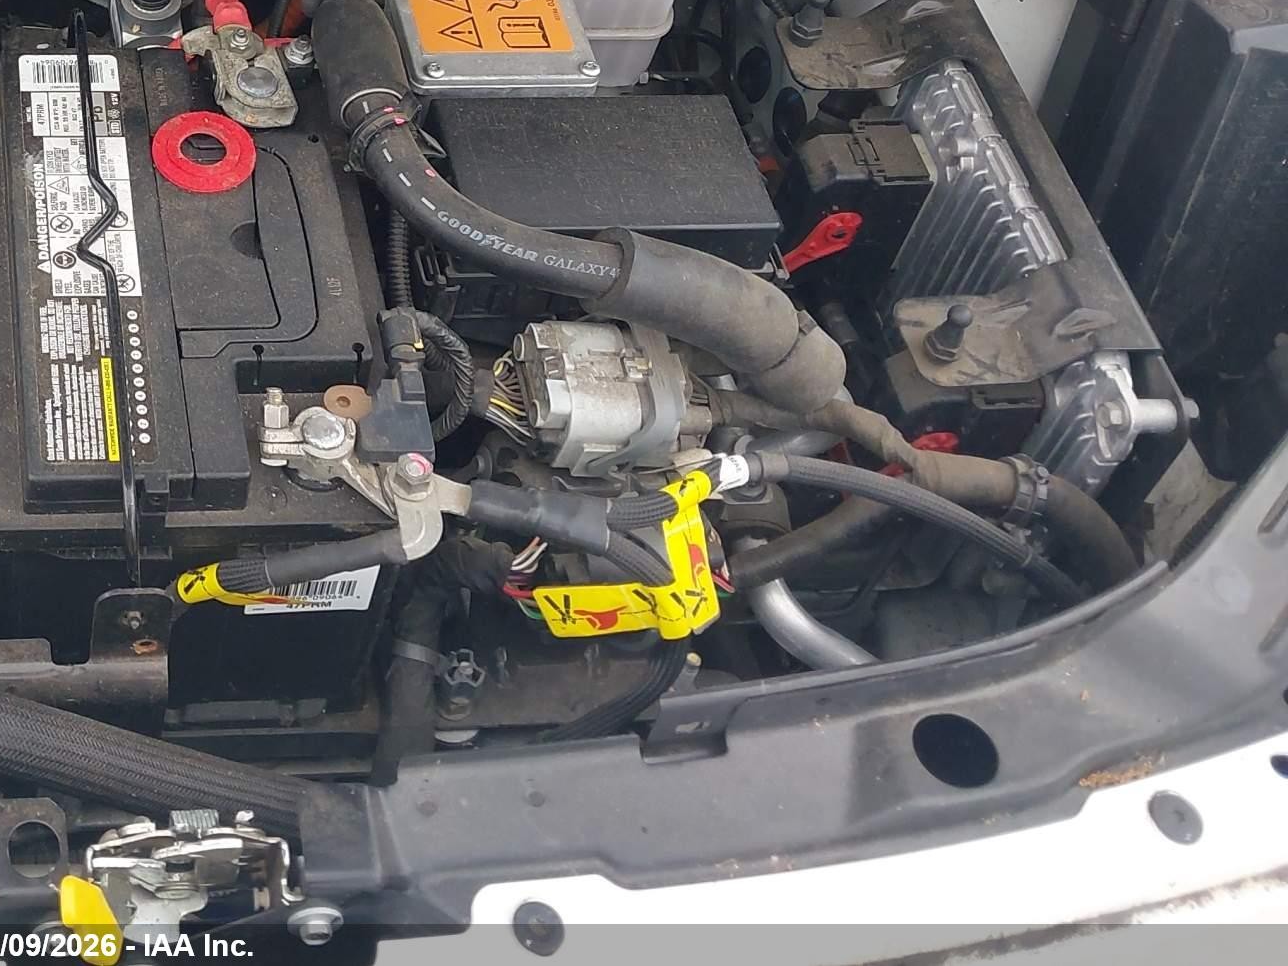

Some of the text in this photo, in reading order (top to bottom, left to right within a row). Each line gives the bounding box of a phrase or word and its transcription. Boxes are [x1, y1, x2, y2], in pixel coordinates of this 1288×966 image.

[111, 93, 119, 106] 12V
[37, 105, 45, 126] 47PRM
[33, 164, 49, 260] DANGER/POISON
[437, 210, 539, 262] GOODYEAR
[73, 271, 82, 294] EXPLOSIVE
